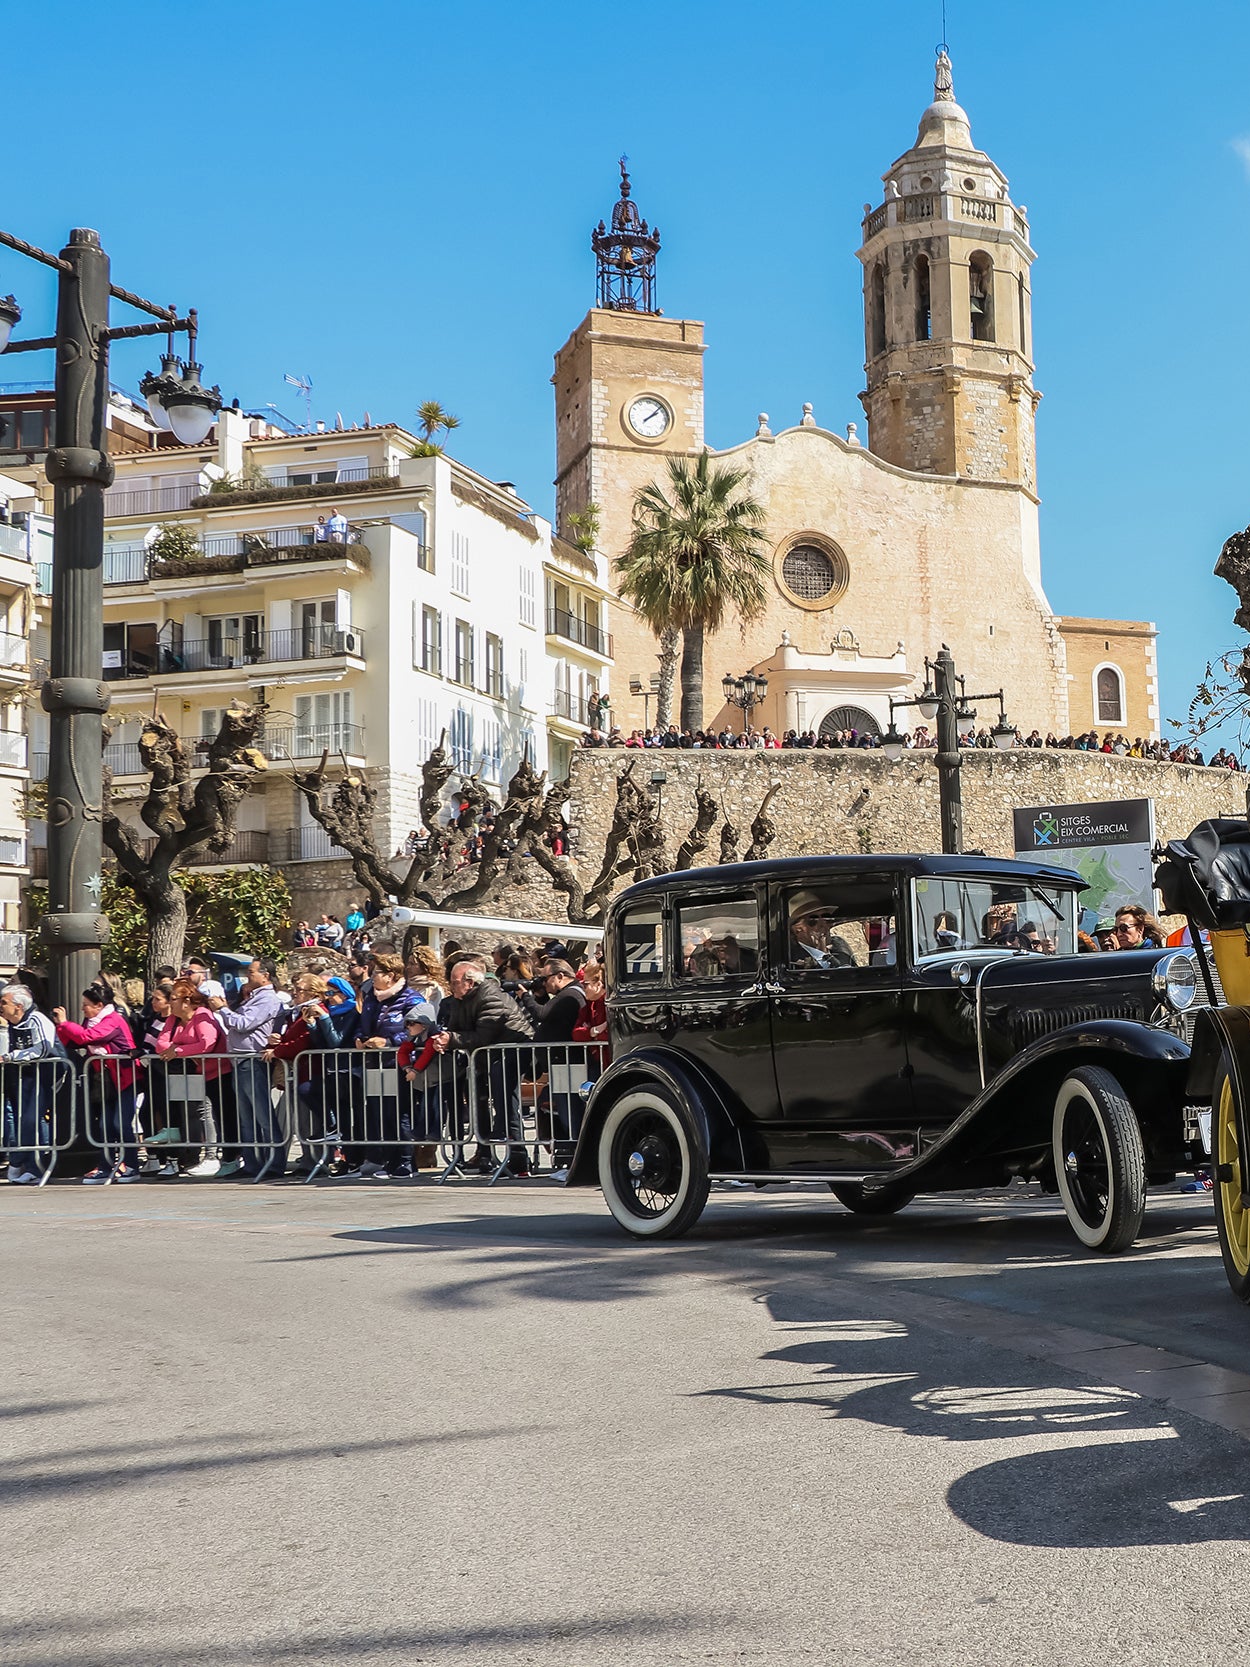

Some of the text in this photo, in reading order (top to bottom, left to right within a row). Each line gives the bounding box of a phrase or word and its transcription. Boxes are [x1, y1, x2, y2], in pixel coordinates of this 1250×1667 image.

[1060, 815, 1091, 827] SITGES
[1061, 823, 1129, 837] EIX COMERCIAL
[223, 972, 233, 990] P
